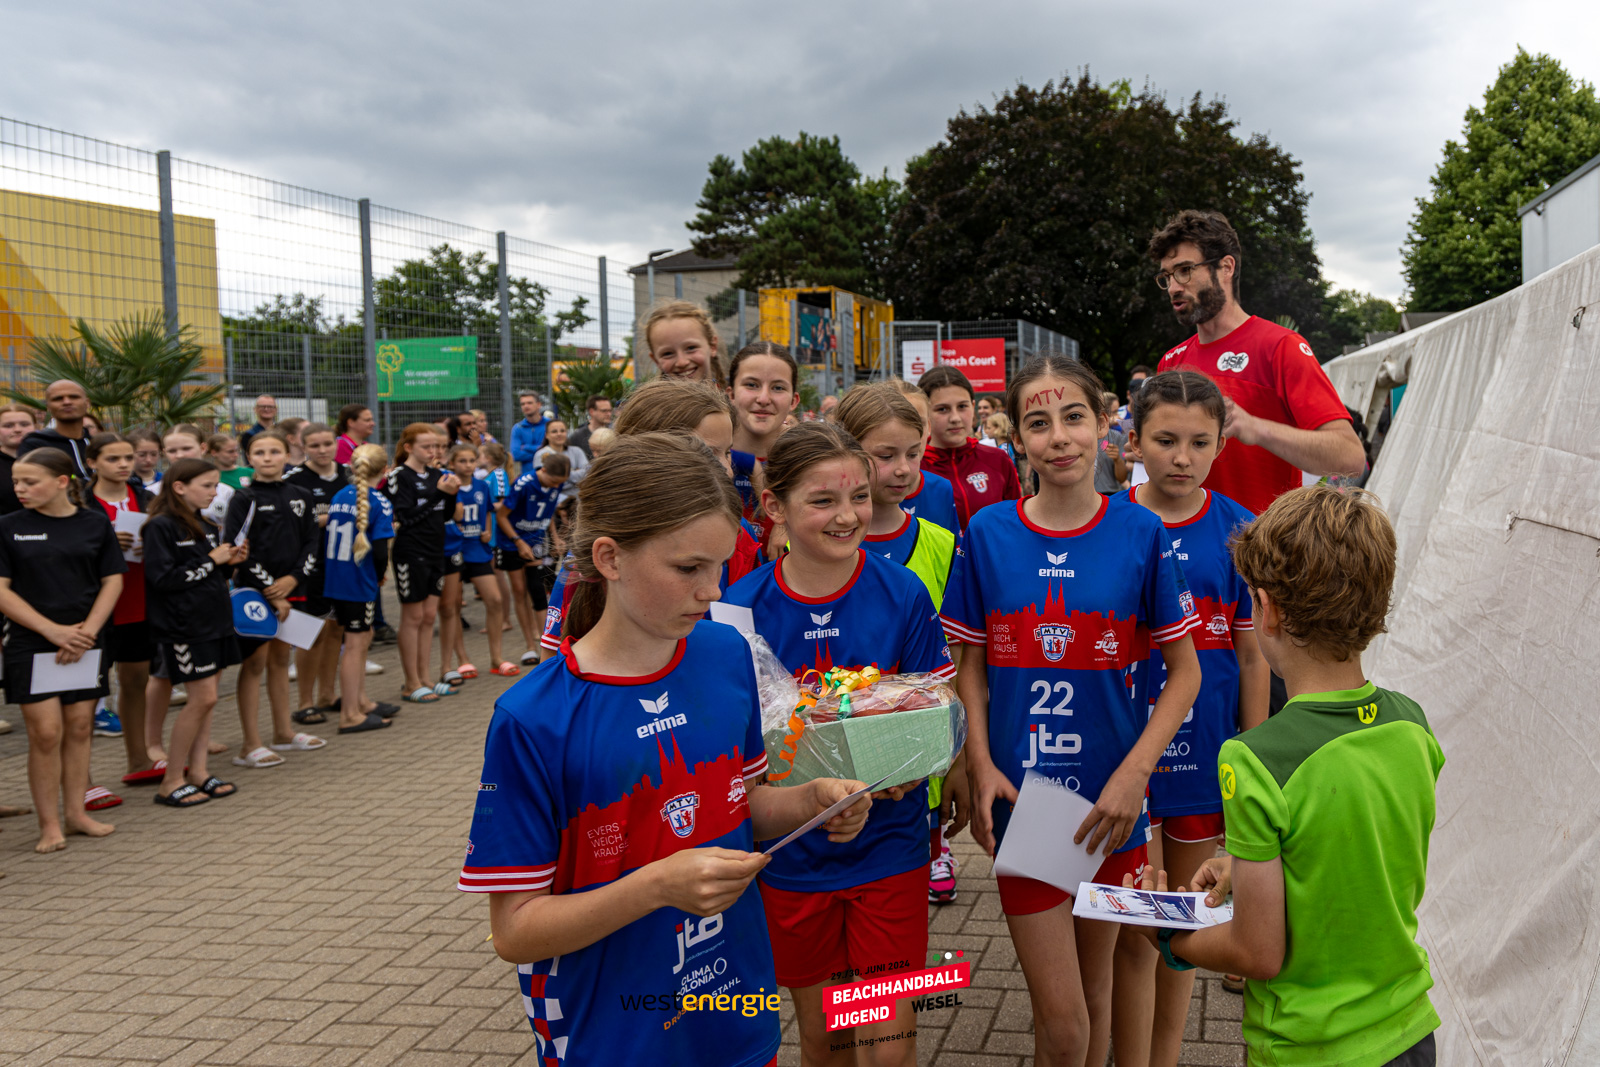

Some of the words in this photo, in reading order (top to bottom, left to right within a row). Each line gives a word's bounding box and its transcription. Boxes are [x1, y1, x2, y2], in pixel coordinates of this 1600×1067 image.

[968, 356, 996, 366] Court
[1026, 386, 1065, 411] MTV
[536, 502, 546, 518] 7
[326, 519, 354, 561] 11
[1038, 566, 1075, 578] erima
[803, 627, 840, 640] erima
[1029, 679, 1074, 716] 22
[636, 713, 688, 739] erima
[1022, 724, 1082, 768] jto
[668, 797, 693, 811] MTV
[587, 822, 620, 839] EVERS
[590, 833, 623, 848] WEICH
[681, 964, 712, 987] CLIMA
